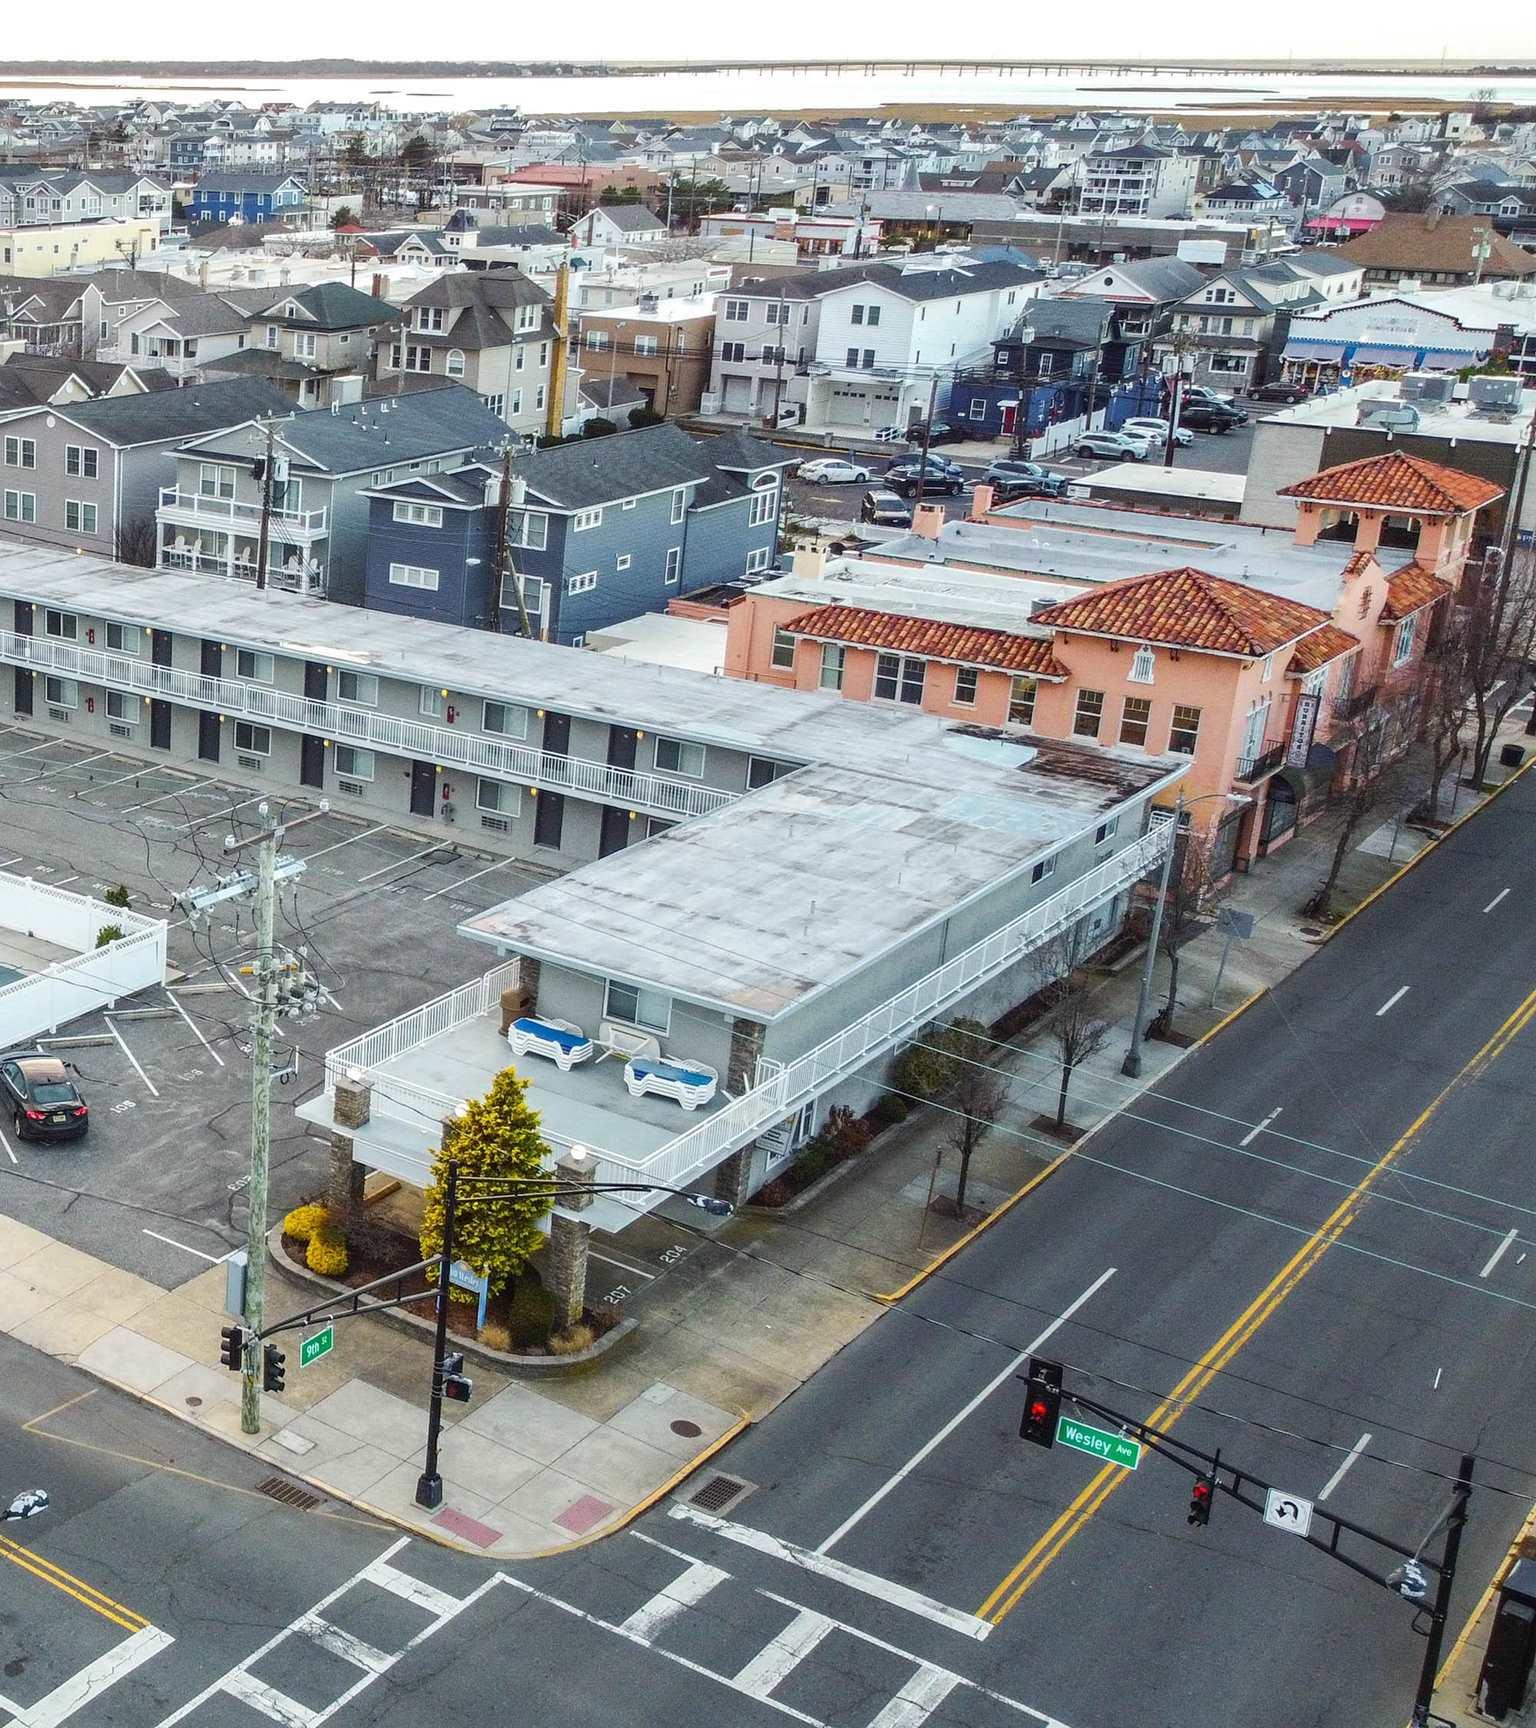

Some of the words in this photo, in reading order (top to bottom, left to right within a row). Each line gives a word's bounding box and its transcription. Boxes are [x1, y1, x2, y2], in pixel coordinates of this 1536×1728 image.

[659, 1244, 688, 1264] 204
[603, 1284, 632, 1304] 207
[306, 1341, 320, 1358] 9th
[1066, 1425, 1112, 1456] Wesley
[1116, 1445, 1133, 1457] Ave
